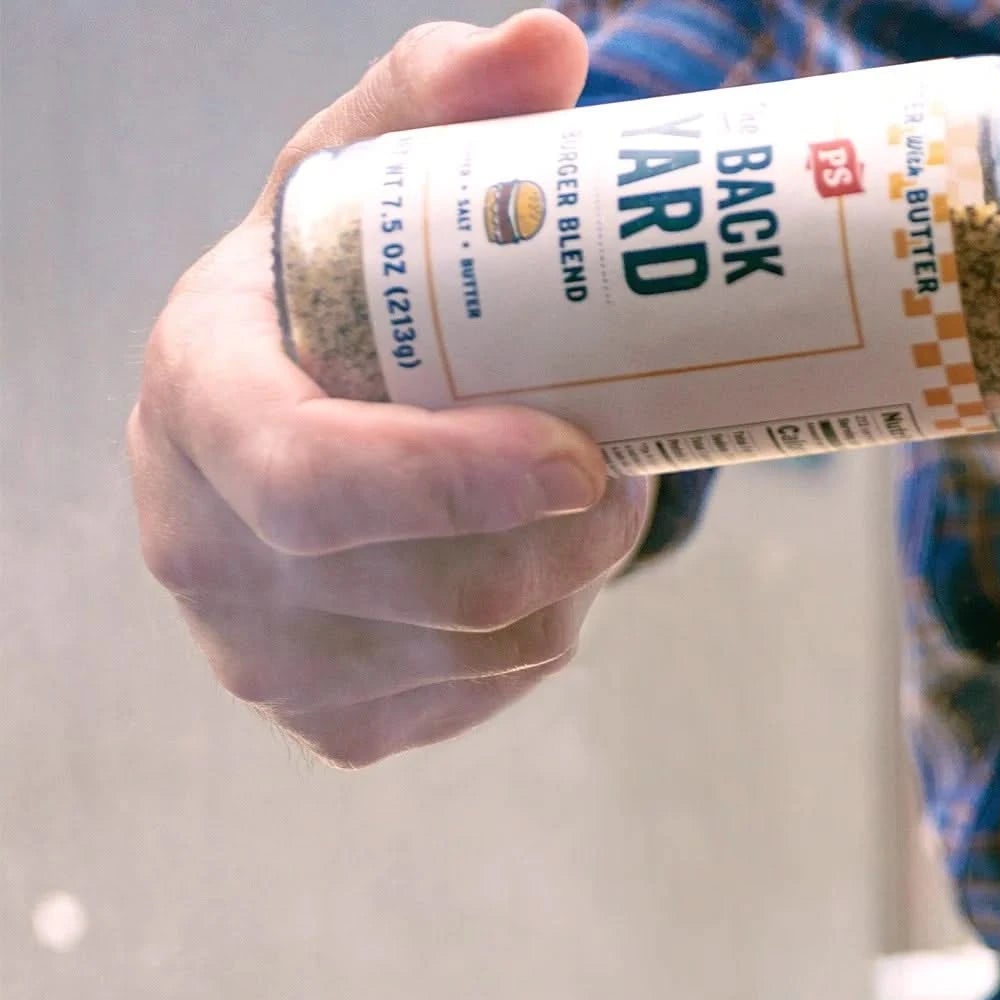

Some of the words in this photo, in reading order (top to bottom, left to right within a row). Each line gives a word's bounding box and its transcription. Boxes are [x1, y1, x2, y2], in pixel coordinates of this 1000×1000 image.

[818, 147, 851, 188] PS
[380, 199, 403, 233] 7.5
[457, 199, 472, 232] SALT
[617, 113, 709, 296] YARD
[716, 145, 784, 285] BACK
[382, 243, 407, 276] OZ
[557, 217, 588, 304] BLEND
[906, 188, 939, 294] BUTTER
[460, 258, 482, 319] BUTTER
[383, 286, 423, 369] (213g)
